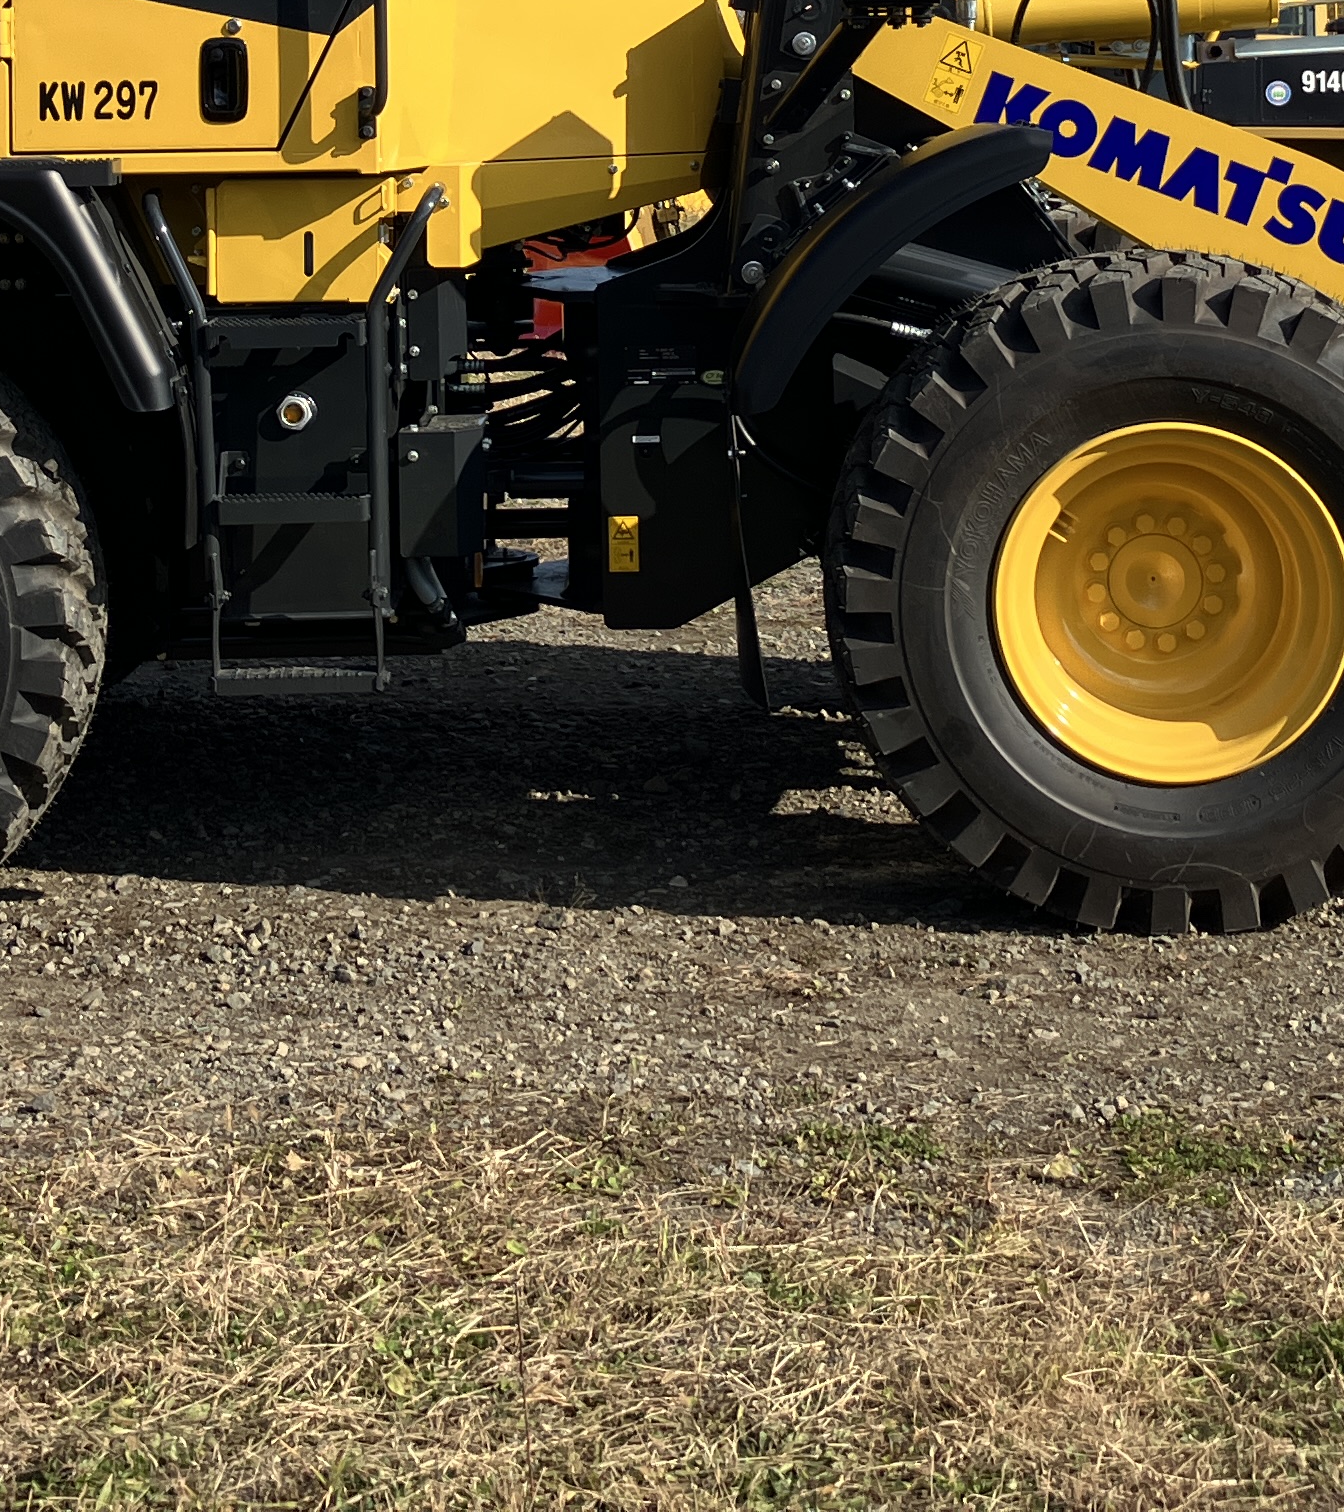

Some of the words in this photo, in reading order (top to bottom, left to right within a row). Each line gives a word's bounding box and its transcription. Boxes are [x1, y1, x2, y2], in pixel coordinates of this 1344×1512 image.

[39, 81, 85, 122] KW
[94, 80, 158, 120] 297
[956, 431, 1053, 576] YOKOHAMA
